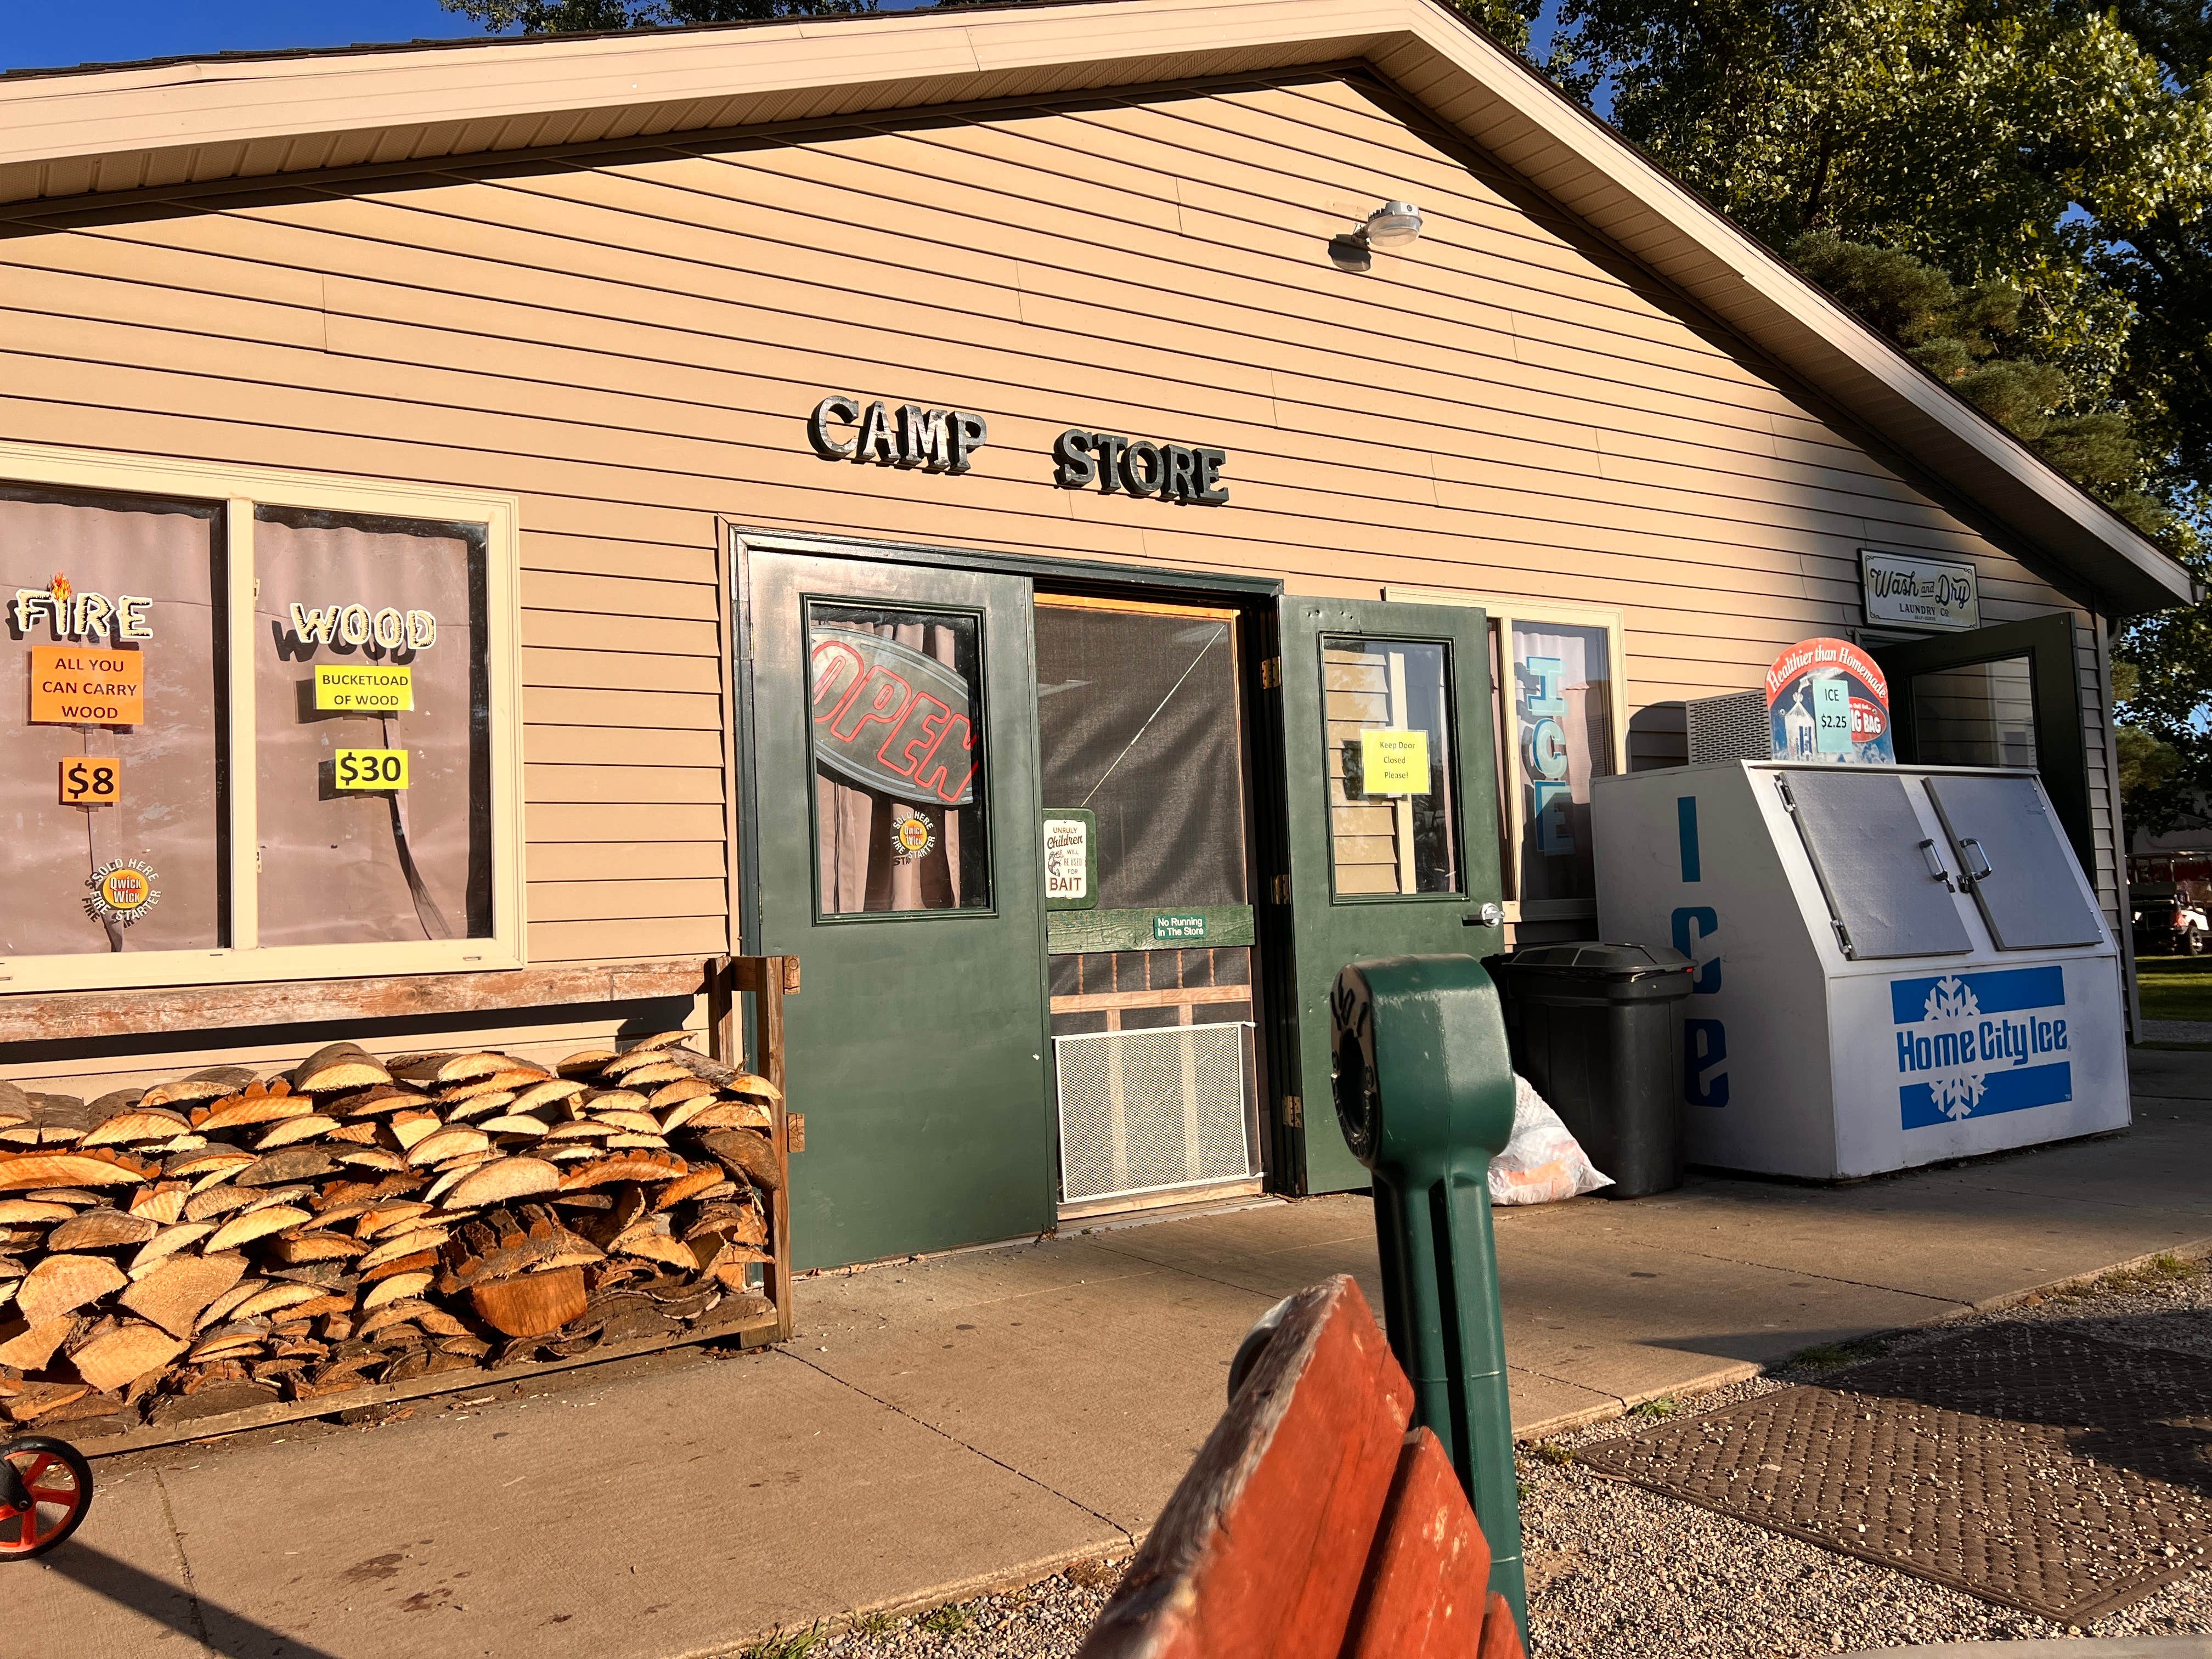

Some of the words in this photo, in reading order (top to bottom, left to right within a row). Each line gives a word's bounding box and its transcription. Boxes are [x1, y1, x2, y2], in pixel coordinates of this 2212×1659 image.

[808, 395, 987, 473] CAMP
[1054, 428, 1229, 505] STORE
[1870, 568, 1919, 598] Wash
[1921, 582, 1935, 594] and
[1935, 574, 1971, 609] Dry
[1899, 603, 1936, 615] LAUNDRY
[14, 588, 153, 639] FIRE
[290, 603, 436, 650] WOOD
[55, 658, 83, 670] ALL
[89, 659, 124, 672] YOU
[1767, 650, 1814, 693] Healthier
[1815, 645, 1836, 662] than
[1838, 647, 1887, 698] Homemade
[42, 681, 77, 693] CAN
[83, 682, 137, 696] CARRY
[323, 674, 409, 686] BUCKETLOAD
[334, 695, 352, 705] OF
[356, 695, 399, 706] WOOD
[1825, 689, 1839, 701] ICE
[61, 706, 118, 719] WOOD
[812, 641, 978, 802] OPEN
[1821, 714, 1847, 729] $2.25
[1850, 709, 1862, 732] IG
[1863, 712, 1882, 733] BAG
[1380, 742, 1397, 750] Keep
[1526, 656, 1575, 856] ICE
[340, 752, 401, 786] $30
[68, 763, 114, 798] $8
[893, 811, 911, 830] SOLD
[914, 811, 934, 830] HERE
[891, 836, 905, 854] FIRE
[909, 836, 935, 859] STARTER
[1047, 834, 1083, 849] Children
[92, 859, 123, 882] SOLD
[128, 858, 159, 881] HERE
[1049, 877, 1081, 891] BAIT
[89, 890, 111, 915] FIRE
[116, 890, 162, 921] STARTER
[1158, 918, 1169, 927] No
[1171, 917, 1203, 927] Running
[1158, 928, 1165, 936] In
[1166, 927, 1182, 936] The
[1183, 927, 1204, 935] Store
[1897, 1030, 1976, 1073] Home
[1979, 1019, 2028, 1066] City
[2030, 1015, 2068, 1053] Ice
